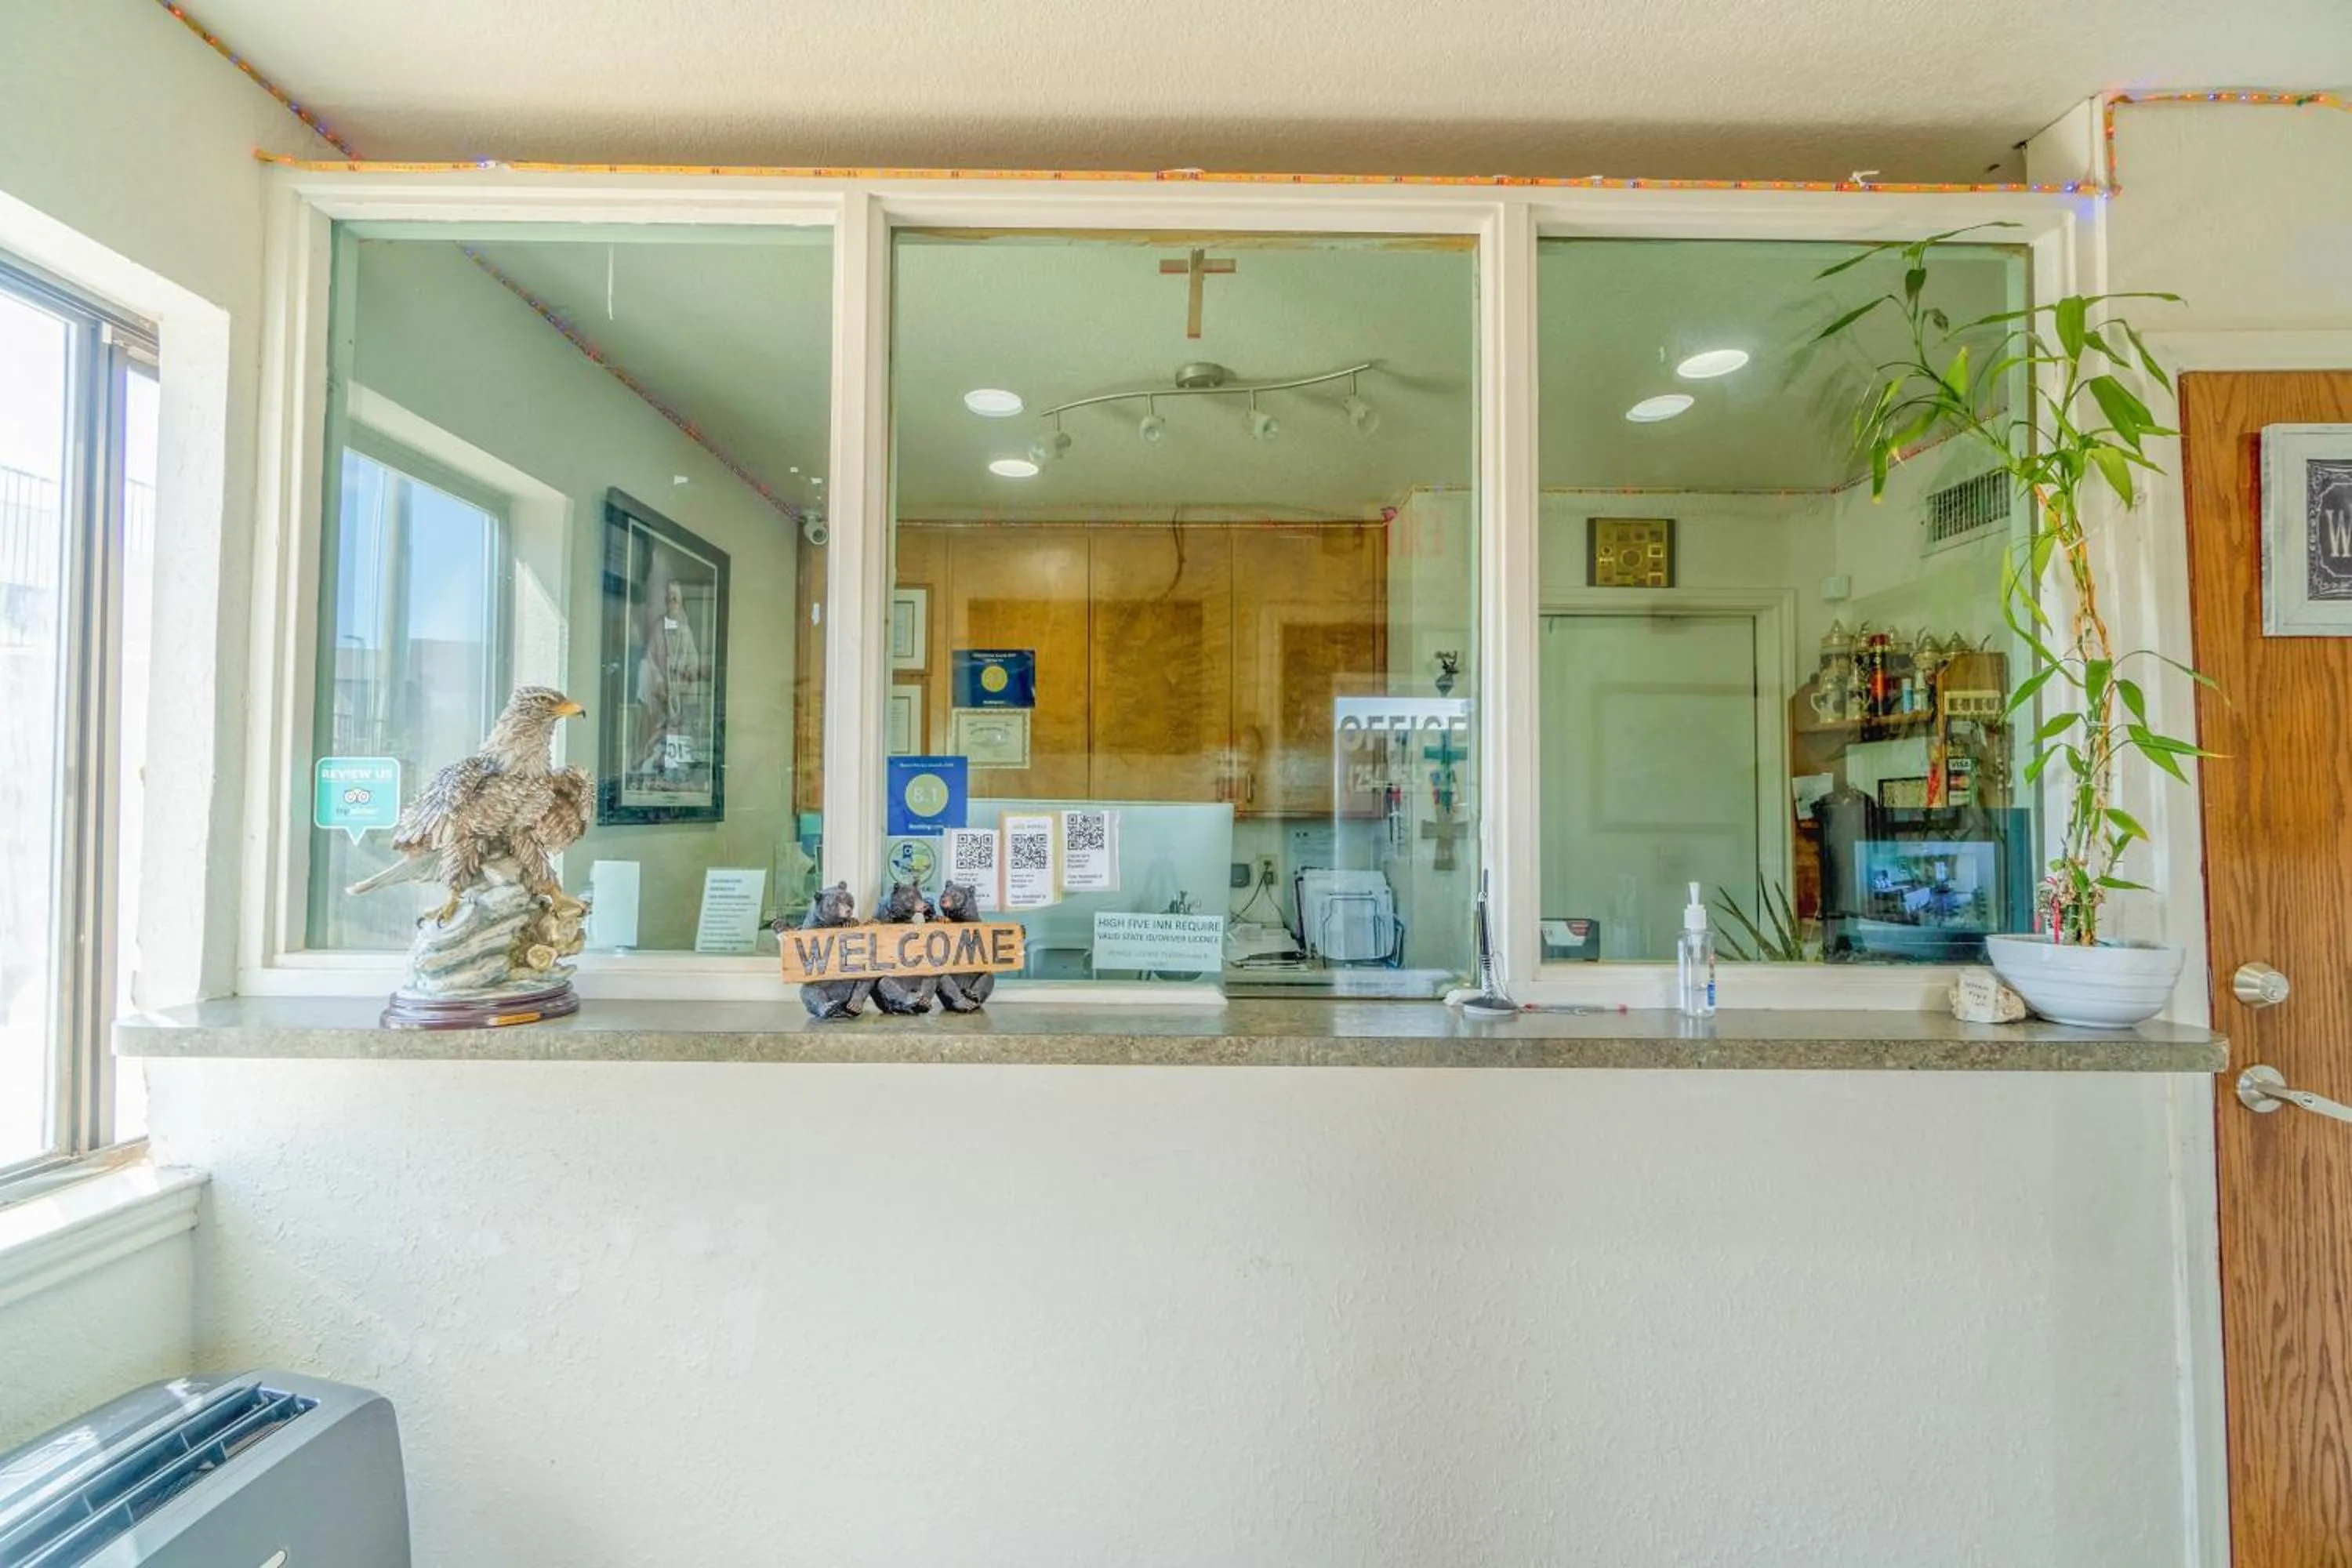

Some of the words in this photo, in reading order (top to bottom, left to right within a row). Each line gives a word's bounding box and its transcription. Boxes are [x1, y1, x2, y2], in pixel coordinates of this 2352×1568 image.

[322, 769, 371, 779] REVIEW
[376, 769, 393, 779] US
[913, 787, 938, 803] 8.1
[1098, 918, 1125, 928] HIGH
[1128, 919, 1152, 929] FIVE
[1153, 920, 1173, 930] INN
[1175, 920, 1221, 932] REQUIRE
[1098, 931, 1120, 940] VALID
[1122, 932, 1143, 941] STATE
[794, 927, 1014, 975] WELCOME
